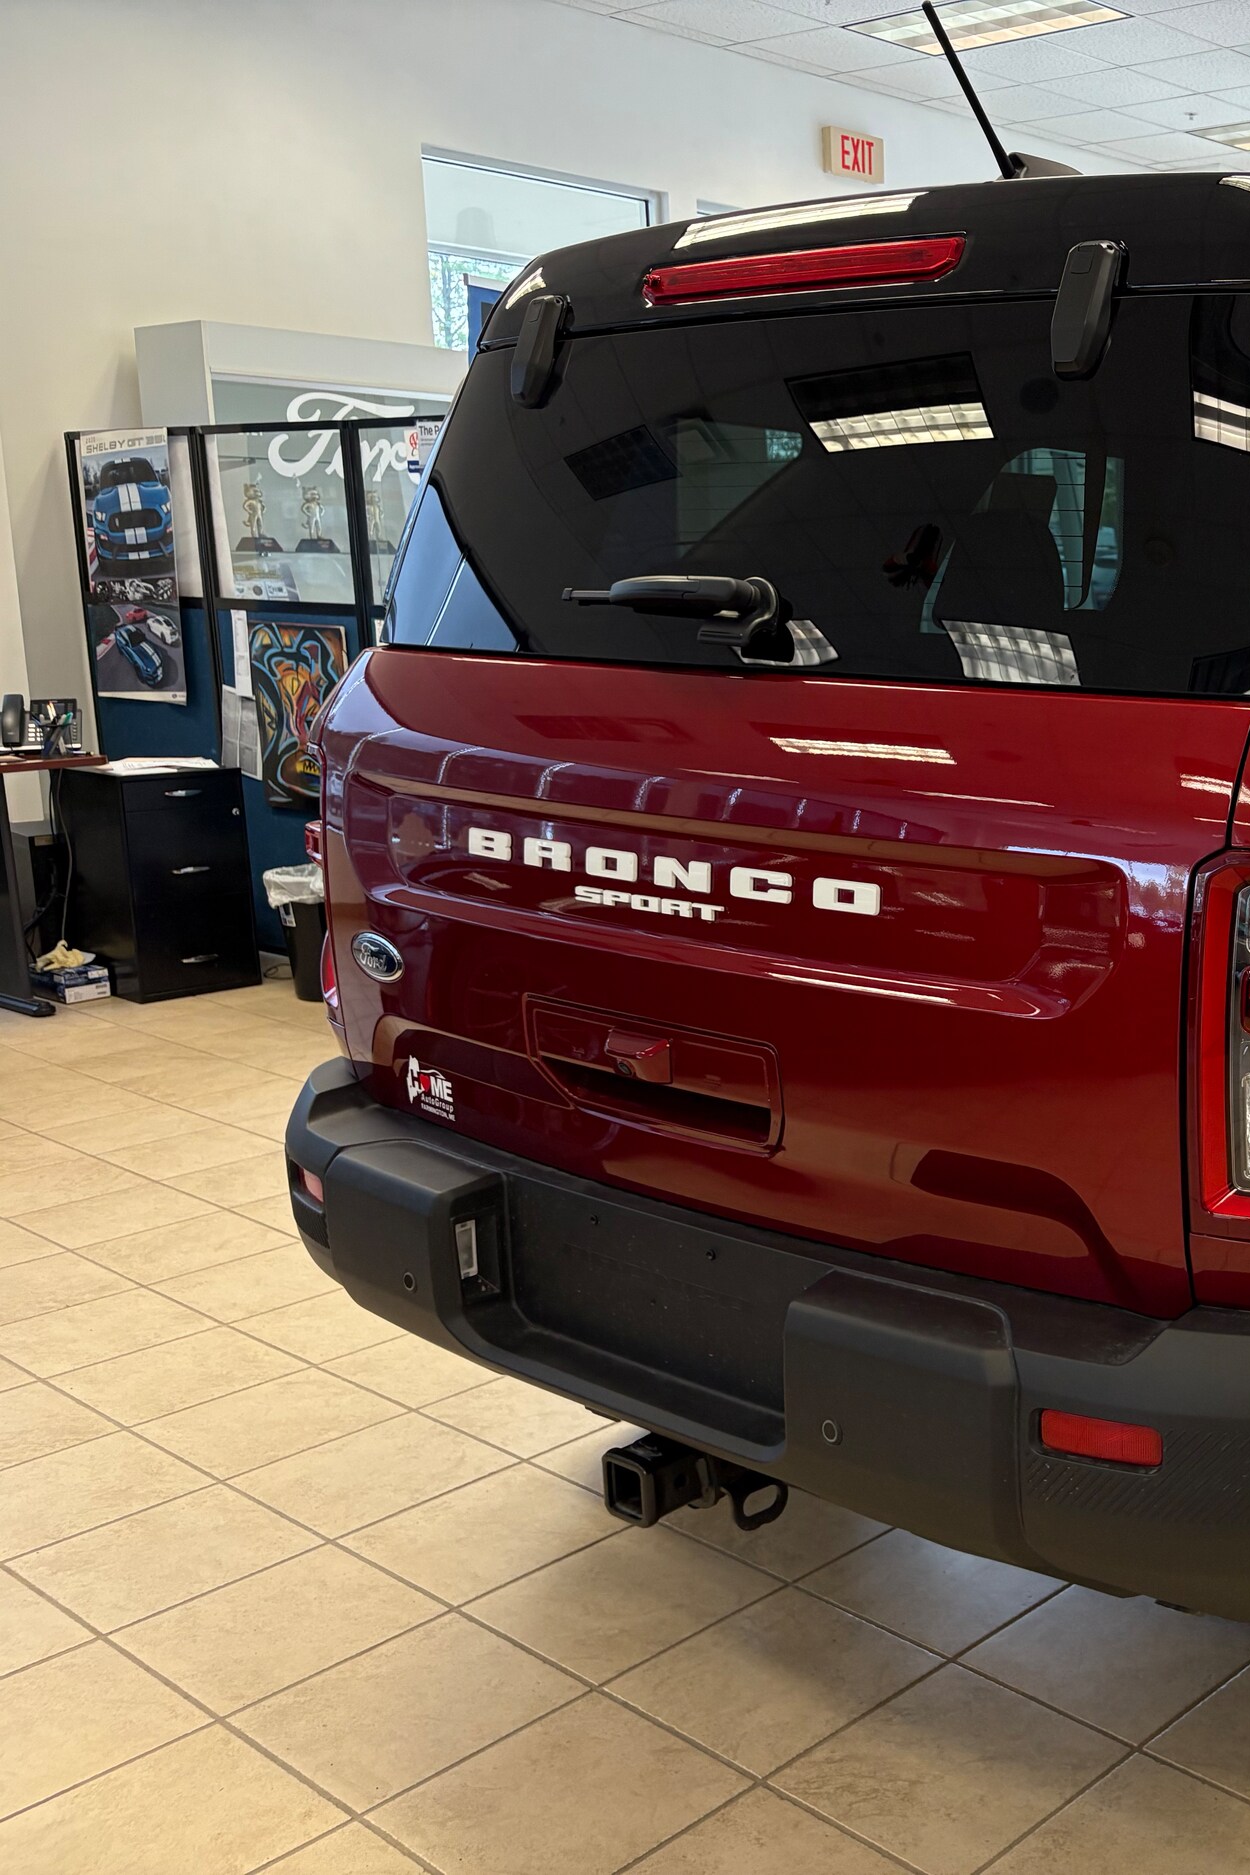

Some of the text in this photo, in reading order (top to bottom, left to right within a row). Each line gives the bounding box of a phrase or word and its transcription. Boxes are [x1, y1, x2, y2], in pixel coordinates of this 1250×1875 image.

[840, 134, 874, 176] EXIT
[86, 440, 125, 454] SHELBY
[127, 437, 144, 448] GT
[418, 425, 440, 436] The P
[468, 827, 881, 916] BRONCO
[575, 885, 724, 922] SPORT
[359, 942, 387, 972] Ford
